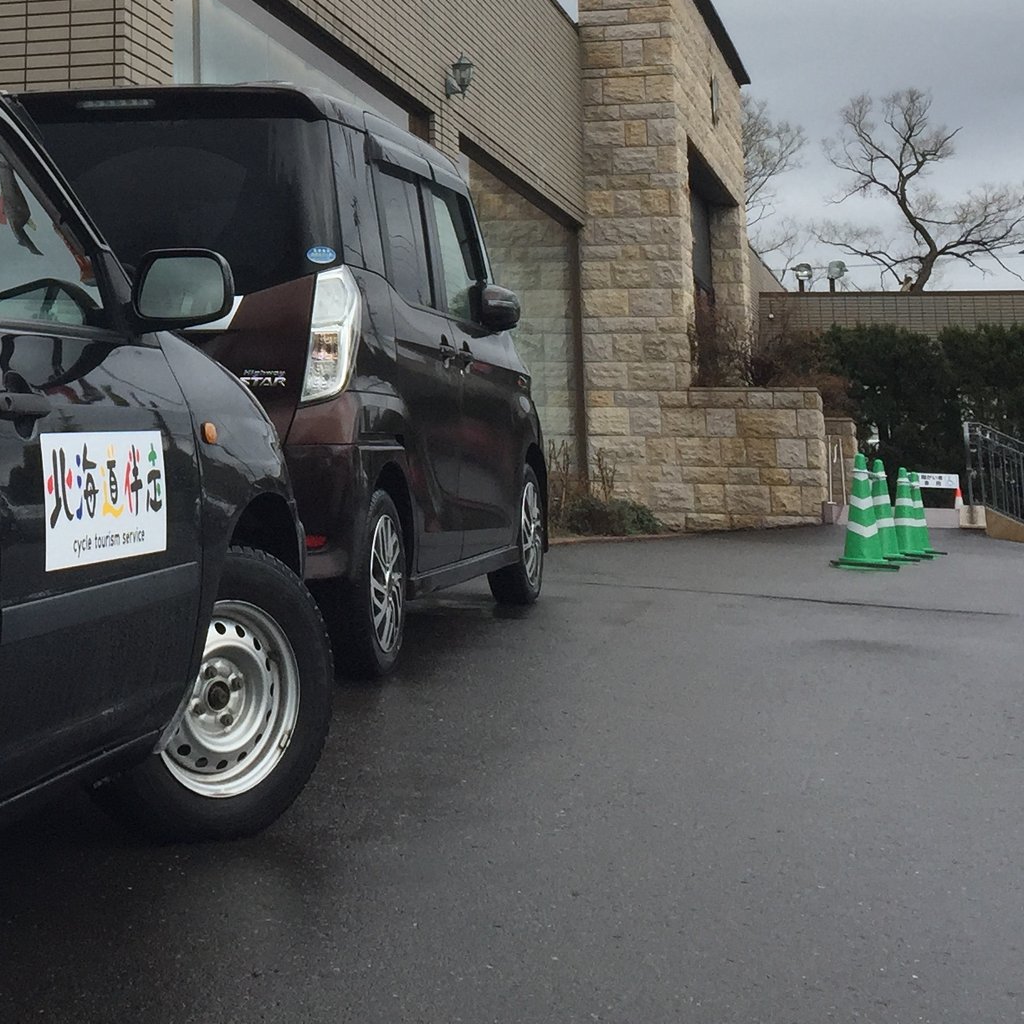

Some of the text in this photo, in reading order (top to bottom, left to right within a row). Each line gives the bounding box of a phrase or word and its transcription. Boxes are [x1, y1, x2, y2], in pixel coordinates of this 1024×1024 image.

[73, 527, 145, 558] cycle tourism service
